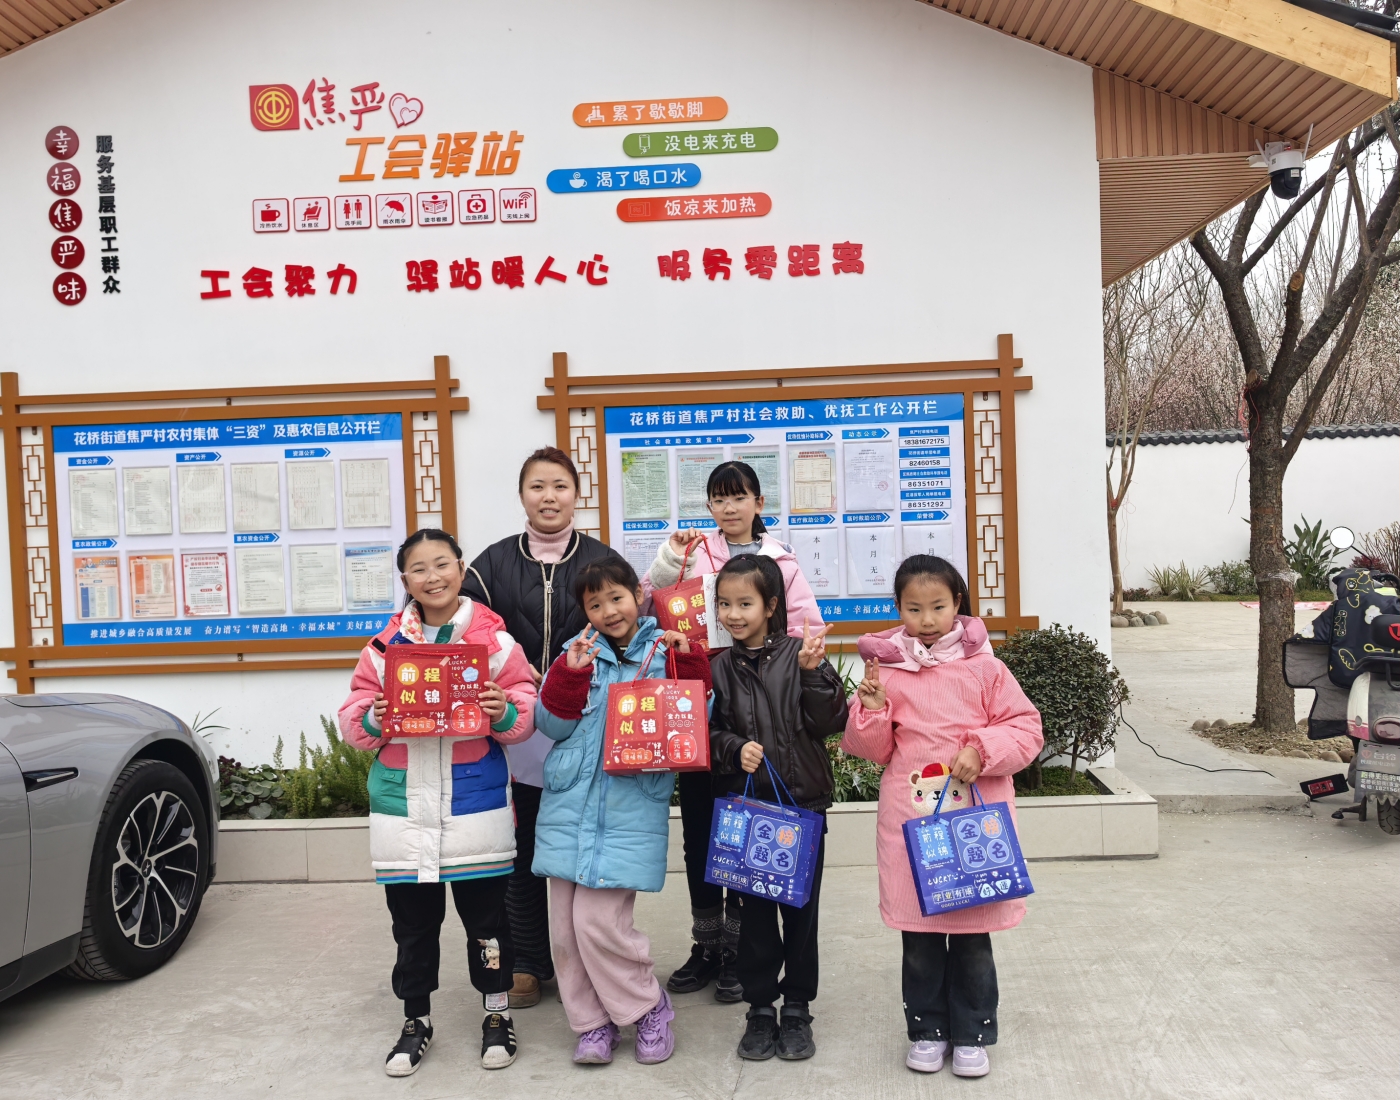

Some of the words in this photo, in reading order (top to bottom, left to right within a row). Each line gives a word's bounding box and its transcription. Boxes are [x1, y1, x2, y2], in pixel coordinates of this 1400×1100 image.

[301, 77, 386, 131] 焦严
[611, 101, 704, 122] 累了歇歇脚
[664, 132, 757, 153] 没电来充电
[338, 130, 525, 183] 工会驿站
[595, 167, 688, 189] 渴了喝口水
[502, 198, 527, 210] WiFi
[664, 197, 758, 217] 饭凉来加热
[51, 130, 83, 302] 幸福焦严味
[95, 134, 121, 295] 服务基层职工群众
[200, 263, 358, 300] 工会聚力
[405, 253, 610, 293] 驿站暖人心
[656, 241, 865, 281] 服务零距离
[644, 436, 723, 445] 社会救助政策宣传
[907, 480, 943, 488] 86351071
[625, 522, 660, 530] 低保长期公示
[680, 520, 714, 528] 新增低保公示
[236, 534, 270, 542] 惠农资金公开
[671, 593, 706, 614] 前程
[89, 626, 193, 639] 推进城乡融合高质量发展
[401, 667, 441, 683] 前程
[400, 689, 441, 705] 似锦
[621, 696, 656, 714] 前程
[620, 718, 657, 735] 似锦
[722, 816, 743, 829] 前程
[960, 817, 999, 840] 金榜
[720, 831, 741, 844] 似锦
[757, 823, 795, 845] 金榜
[922, 830, 945, 843] 前程
[712, 854, 734, 867] LUCKY
[753, 845, 789, 868] 题名
[925, 846, 949, 859] 似锦
[966, 842, 1007, 864] 题名
[927, 875, 953, 886] LUCKY
